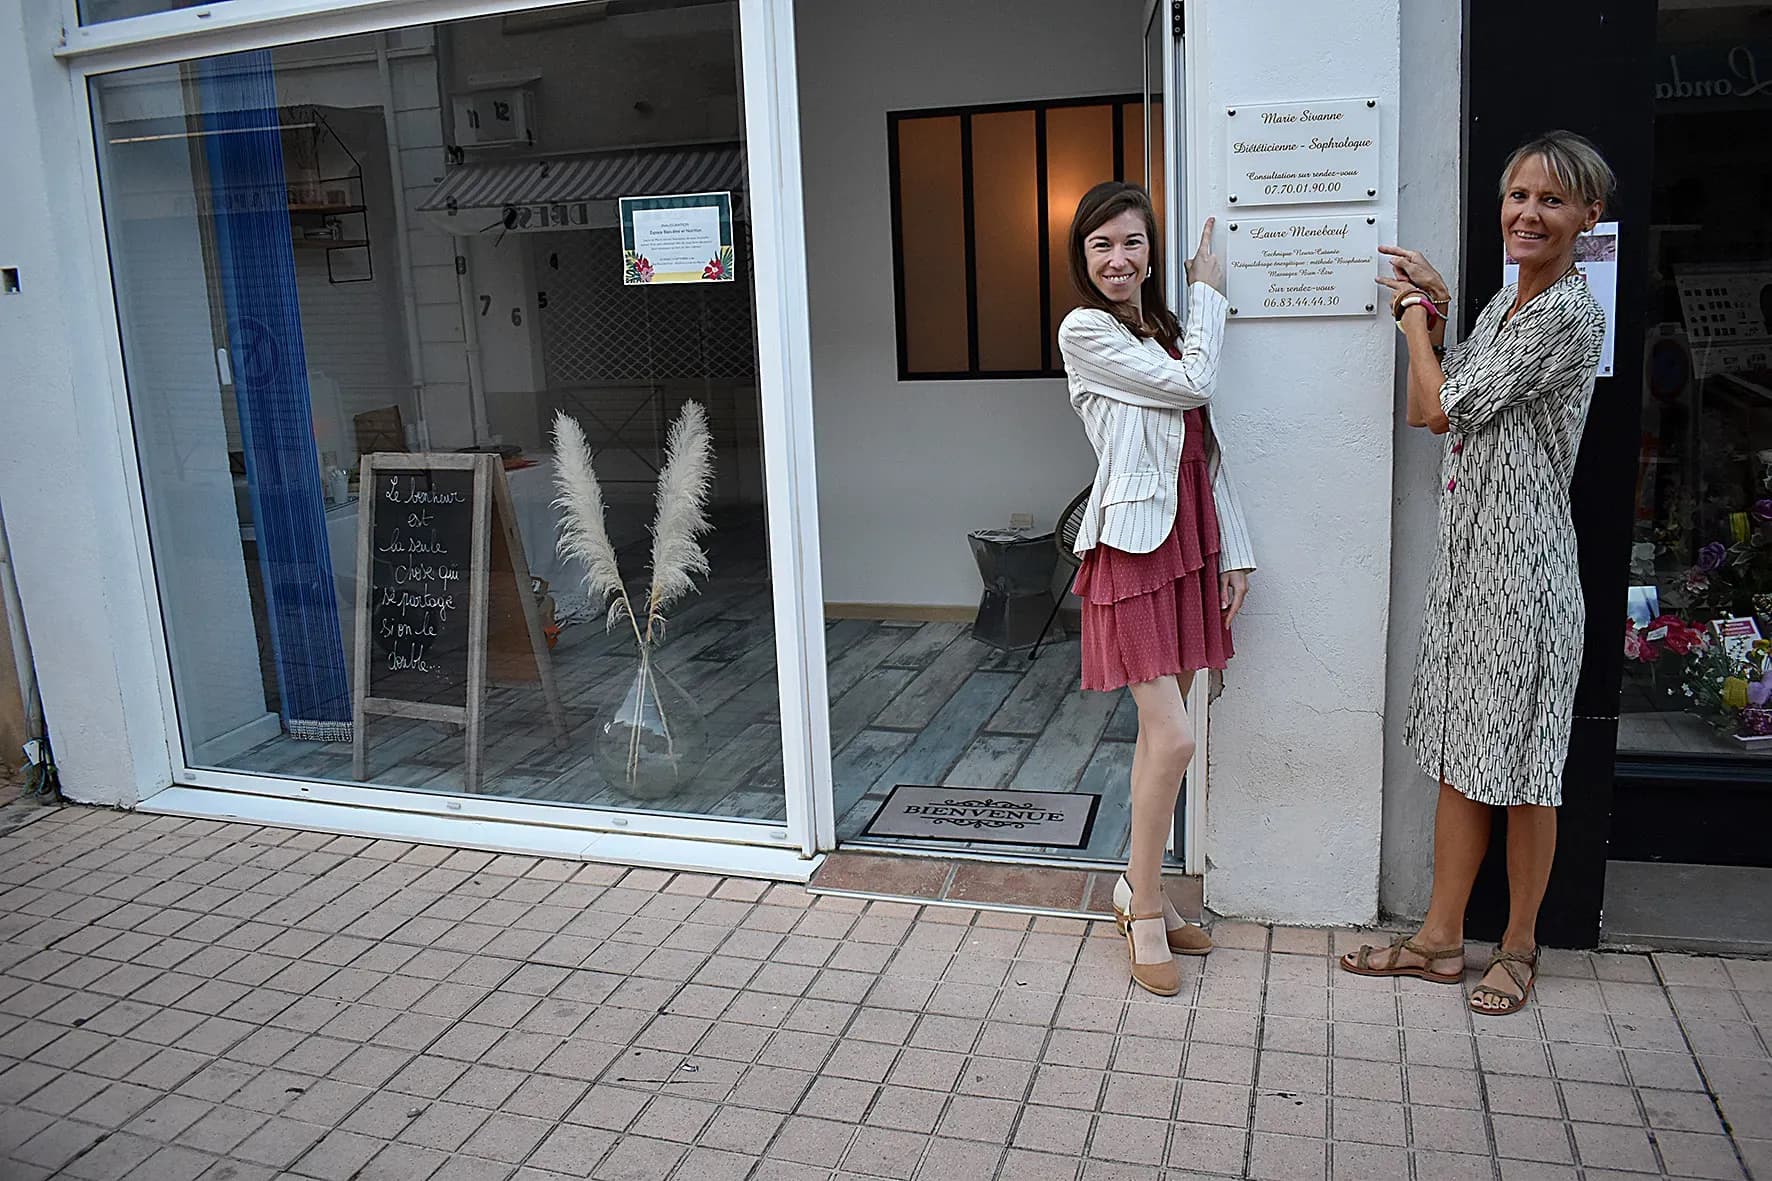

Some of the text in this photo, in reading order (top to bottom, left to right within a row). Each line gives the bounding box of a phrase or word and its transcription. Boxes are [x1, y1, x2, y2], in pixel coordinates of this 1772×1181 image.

[467, 109, 481, 129] 11
[494, 100, 509, 121] 12
[1261, 109, 1344, 124] Marie Sivanne
[1233, 141, 1298, 154] Diététicienne
[1308, 136, 1373, 152] Sophrologue
[1246, 171, 1297, 181] Consultation
[1312, 168, 1359, 178] rendez-vous
[1264, 181, 1341, 195] 07.70.01.90.00
[1250, 226, 1288, 239] Laure
[1268, 282, 1336, 293] Sur rendez-vous
[480, 295, 491, 316] 7
[537, 291, 548, 309] 5
[1263, 295, 1341, 308] 06.83.44.44.30
[511, 307, 522, 328] 6
[385, 475, 465, 504] Le bonheur
[408, 508, 434, 528] est
[408, 528, 448, 554] seule
[438, 562, 460, 592] qui
[382, 584, 456, 622] se partage
[397, 622, 413, 638] on
[414, 611, 437, 638] le
[902, 805, 1066, 823] BIENVENUE
